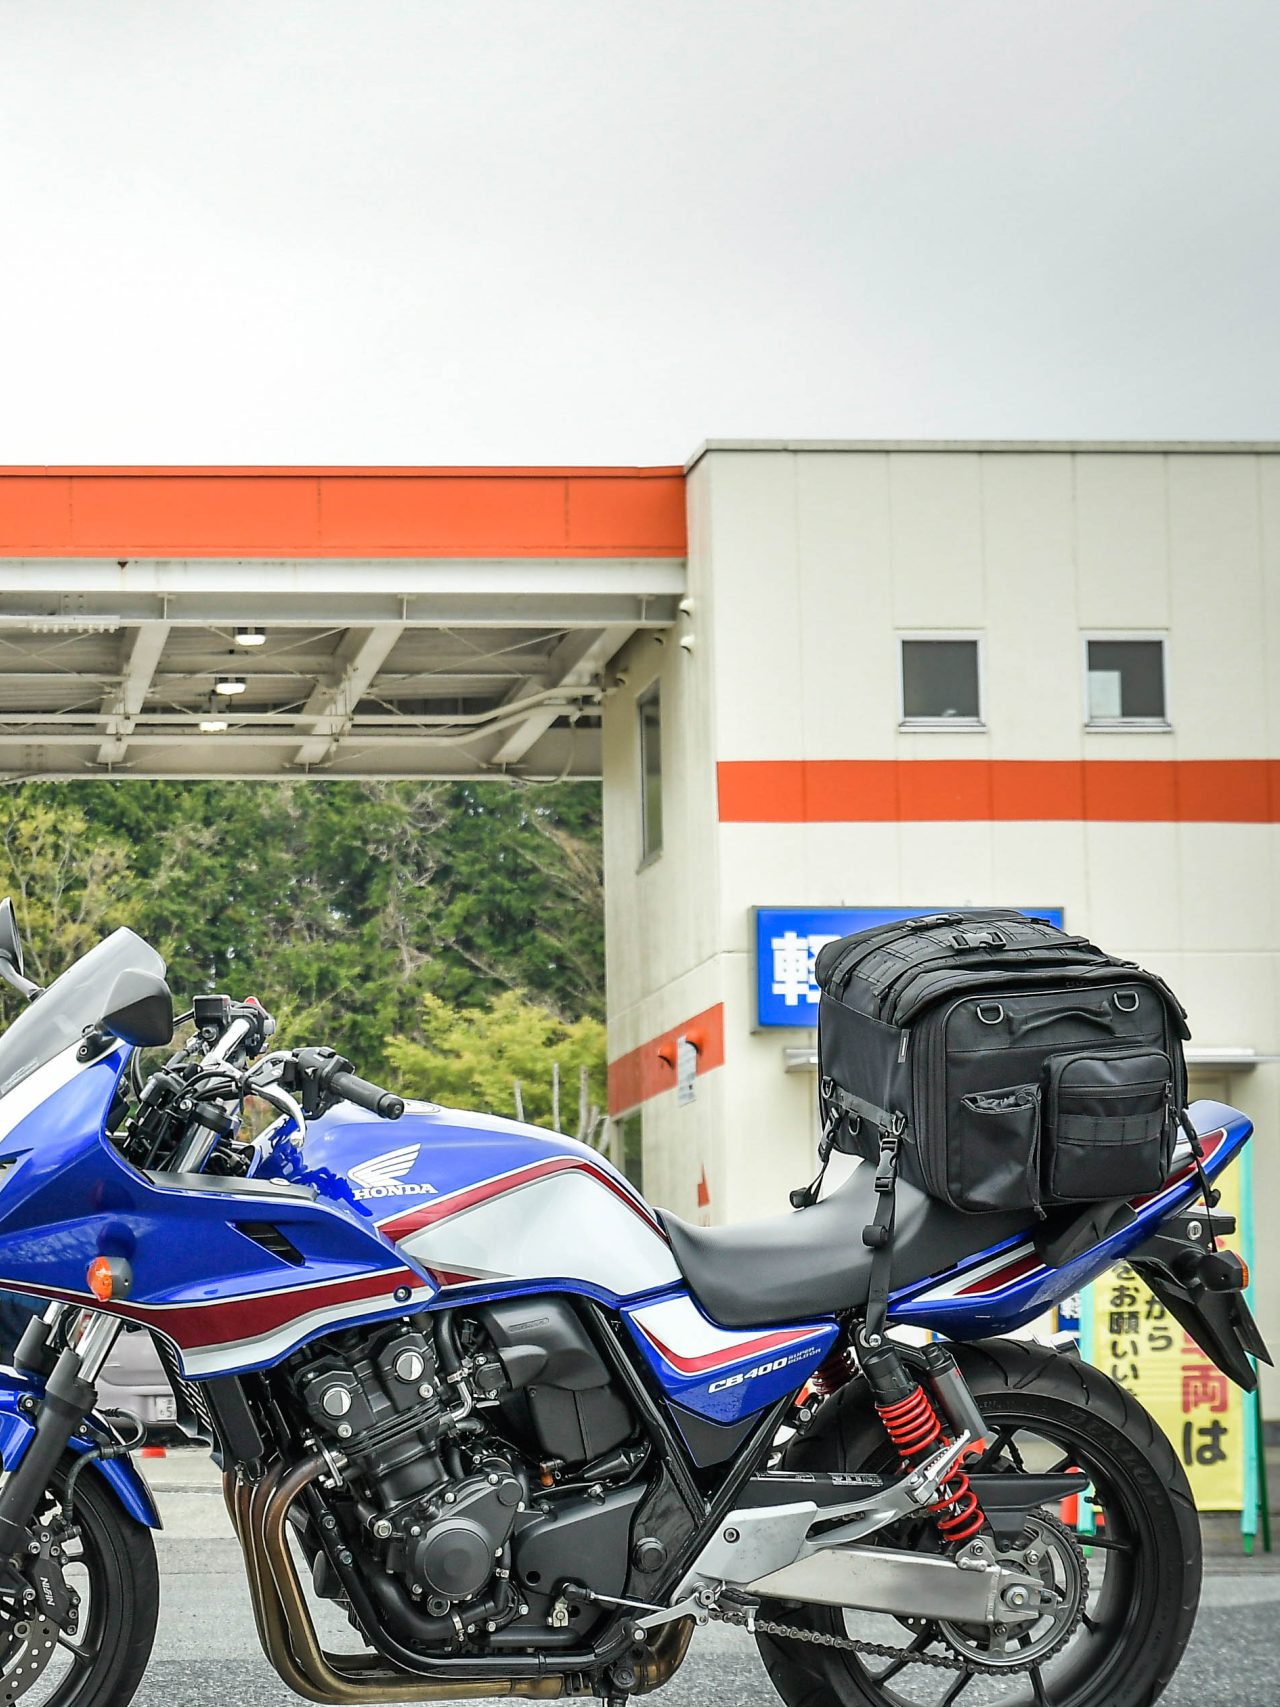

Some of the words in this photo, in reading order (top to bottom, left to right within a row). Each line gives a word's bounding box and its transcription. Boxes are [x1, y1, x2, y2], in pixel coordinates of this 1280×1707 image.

[352, 1183, 439, 1201] HONDA
[788, 1346, 815, 1360] SUPER
[708, 1357, 788, 1394] CB400
[1180, 1331, 1229, 1467] 両は
